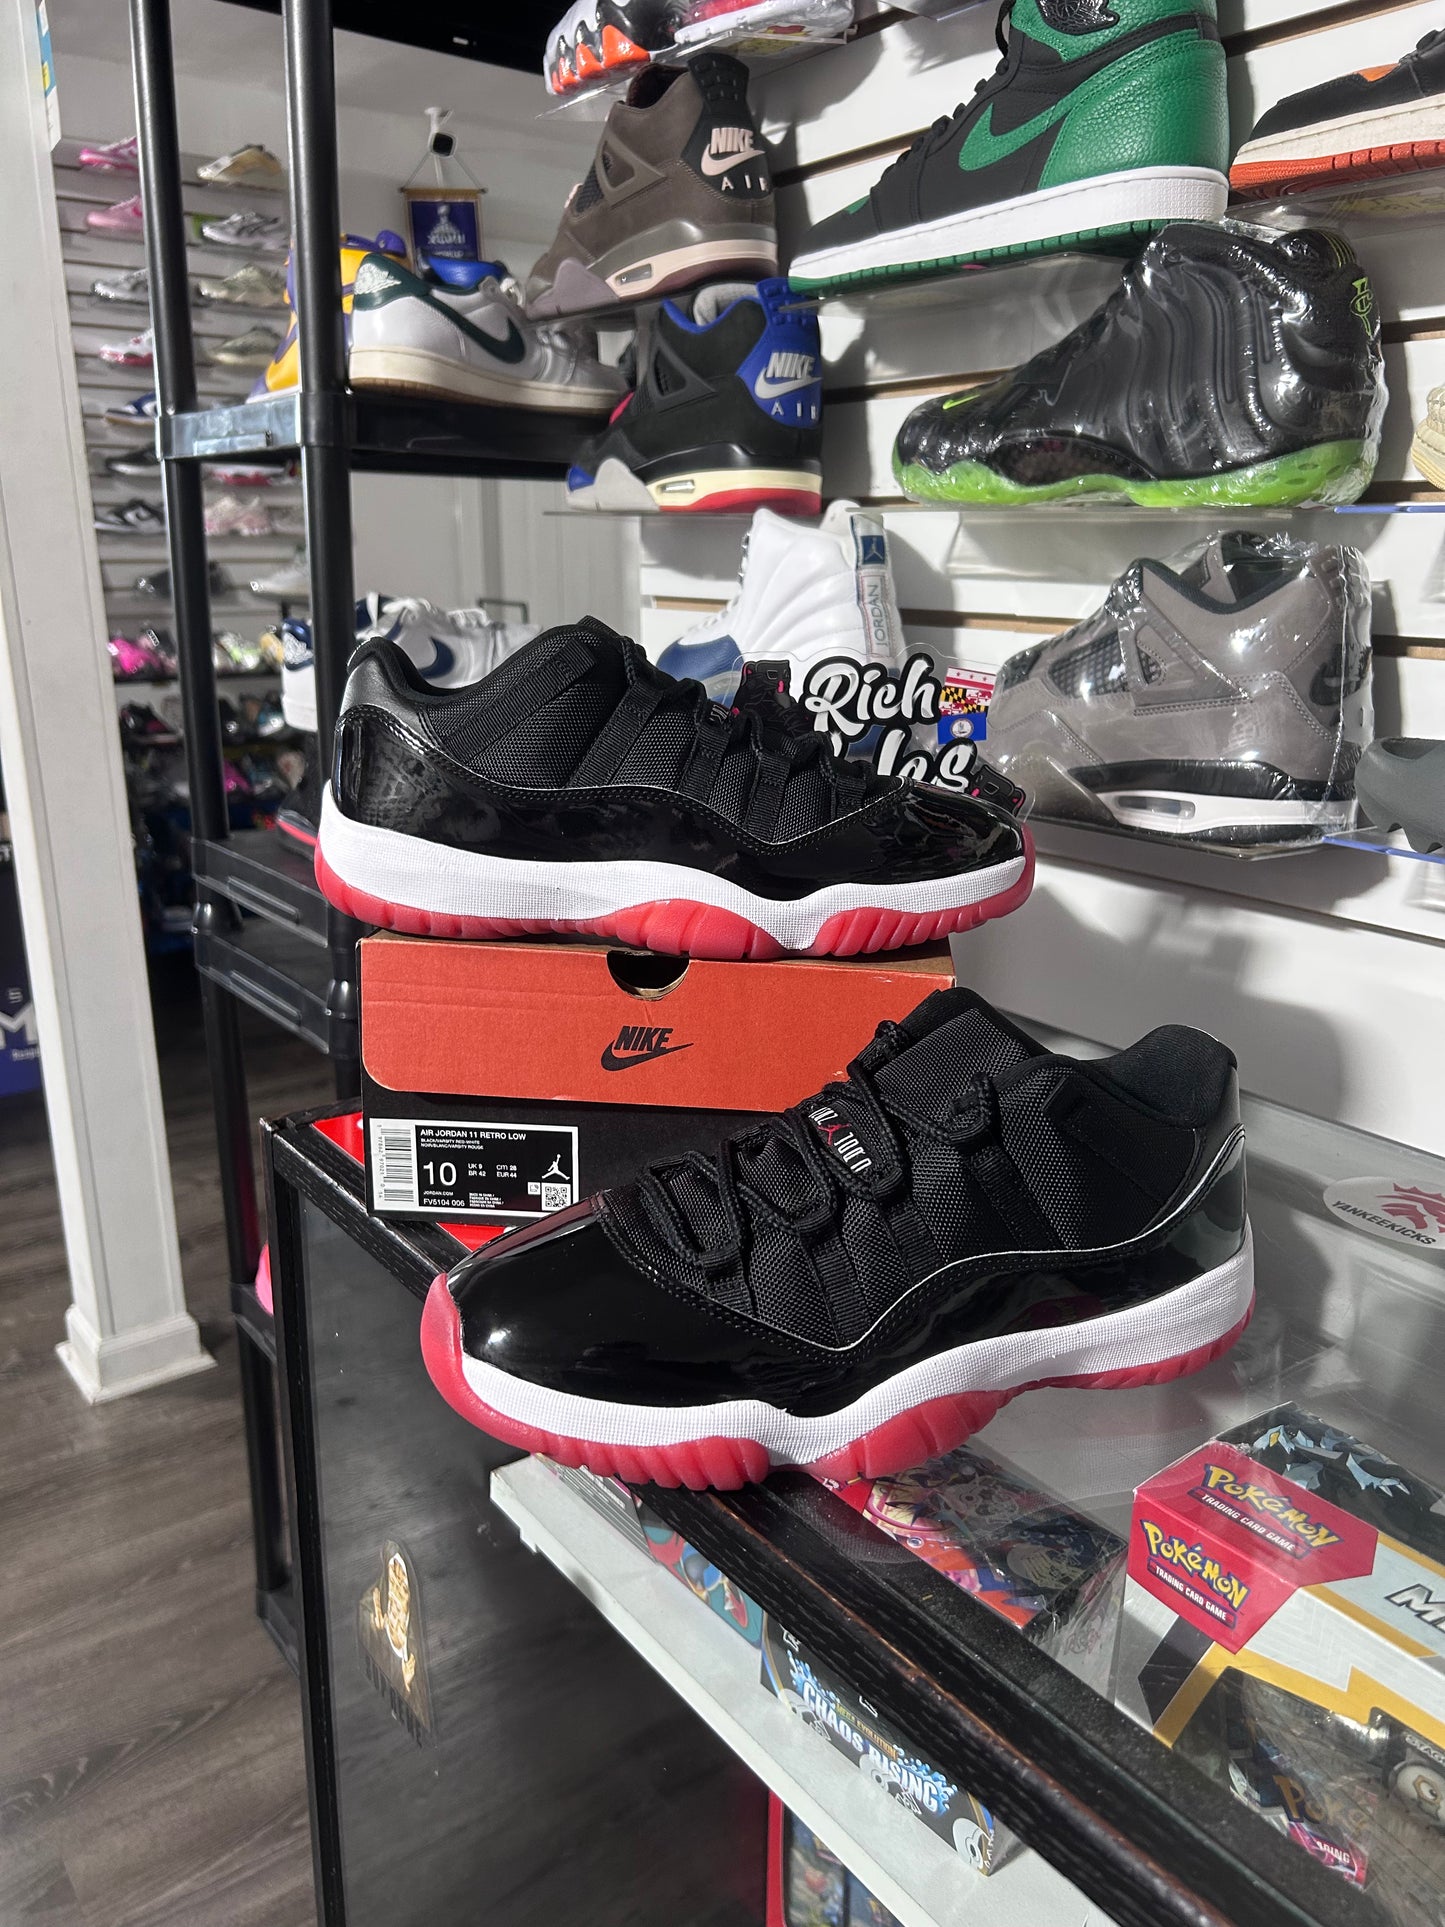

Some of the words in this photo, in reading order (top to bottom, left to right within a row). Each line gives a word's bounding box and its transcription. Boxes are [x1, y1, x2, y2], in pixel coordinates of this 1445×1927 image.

[710, 127, 754, 155] NIKE
[766, 352, 815, 379] NIKE
[867, 584, 888, 647] JORDAN
[804, 657, 937, 737] Rich
[613, 1025, 674, 1052] NIKE
[420, 1129, 434, 1137] AIR
[435, 1130, 468, 1138] JORDAN
[480, 1131, 507, 1140] RETRO
[508, 1133, 526, 1141] LOW
[422, 1161, 457, 1186] 10
[423, 1198, 450, 1206] FV5104
[451, 1199, 466, 1207] 006
[1332, 1200, 1437, 1245] YANKEEKICKS
[1201, 1494, 1241, 1519] TRADING
[1240, 1515, 1267, 1534] CARD
[1266, 1532, 1296, 1552] GAME
[1155, 1565, 1184, 1592] TRADING
[1185, 1587, 1204, 1606] CARD
[1205, 1600, 1227, 1621] GAME
[803, 1681, 864, 1753] CHAOS
[868, 1742, 940, 1813] RISING
